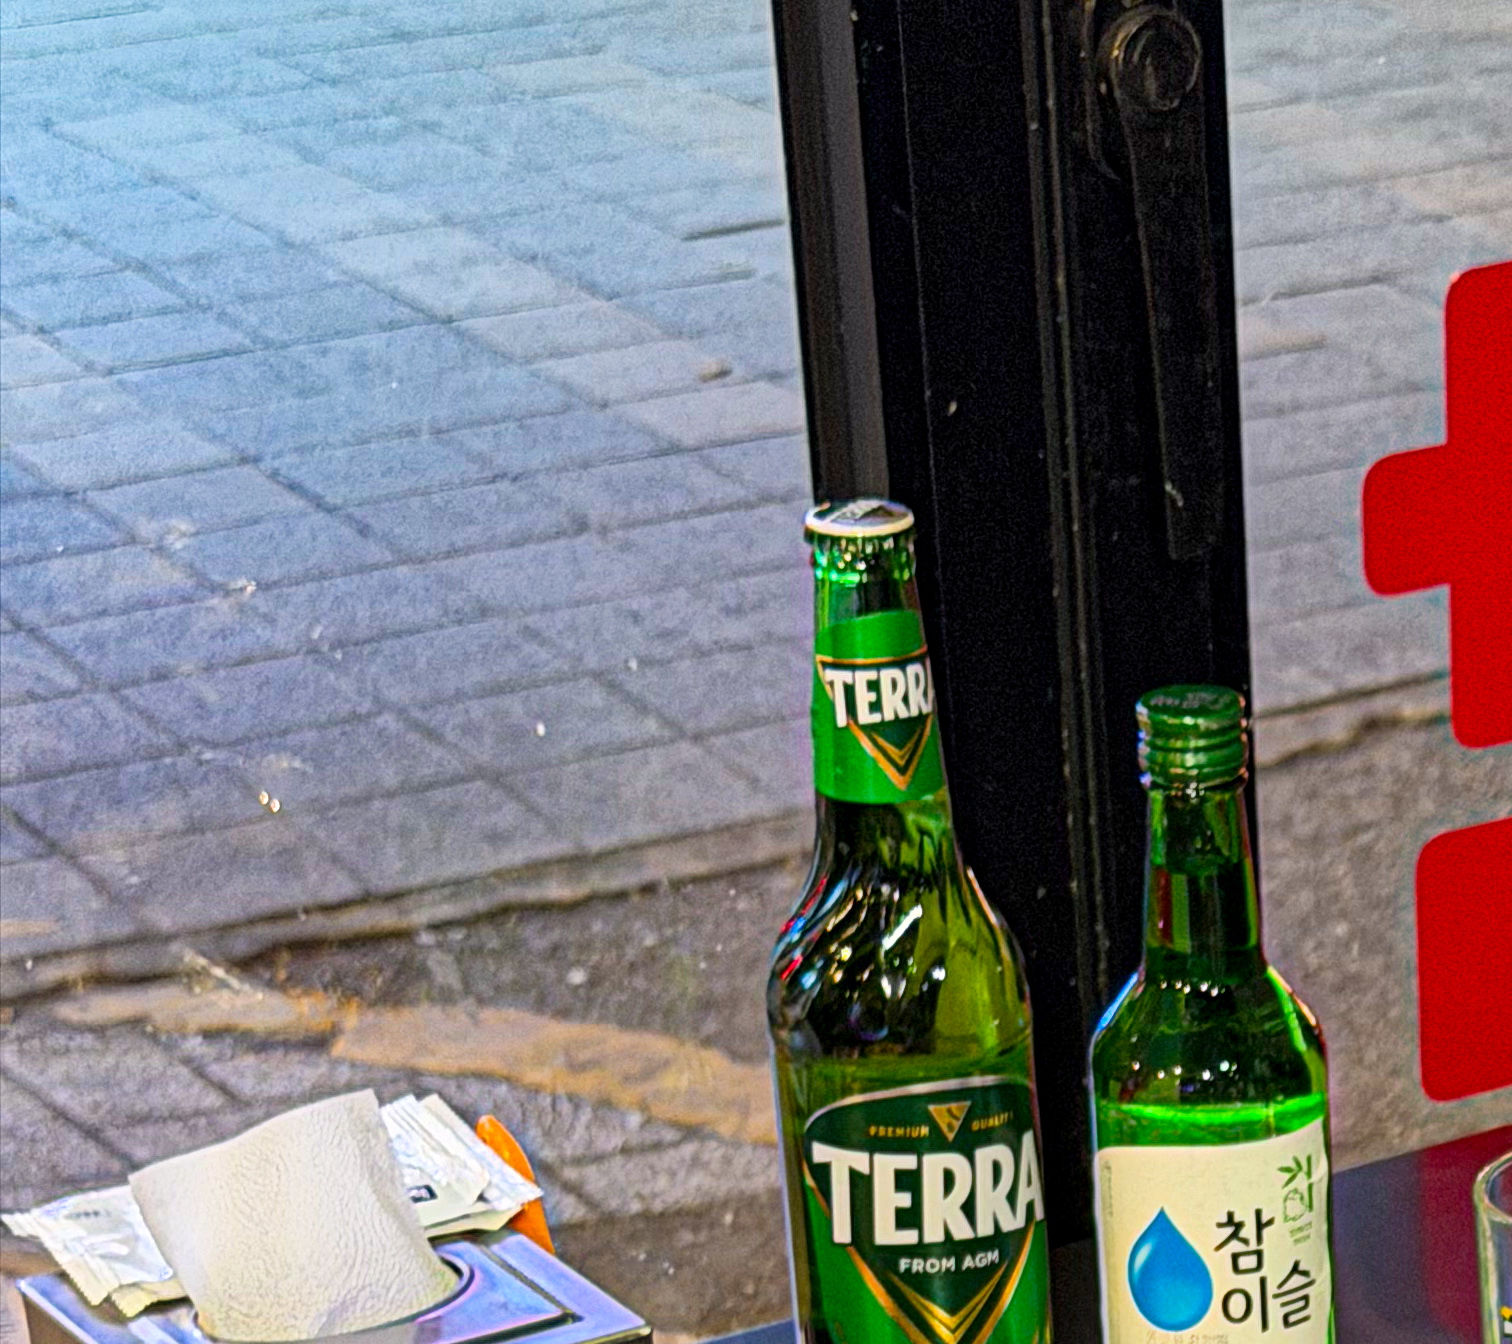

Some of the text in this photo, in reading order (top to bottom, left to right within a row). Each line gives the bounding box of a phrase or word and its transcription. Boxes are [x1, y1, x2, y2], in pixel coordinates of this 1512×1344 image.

[811, 1129, 1045, 1246] TERRA
[899, 1248, 1000, 1274] FROM AGM
